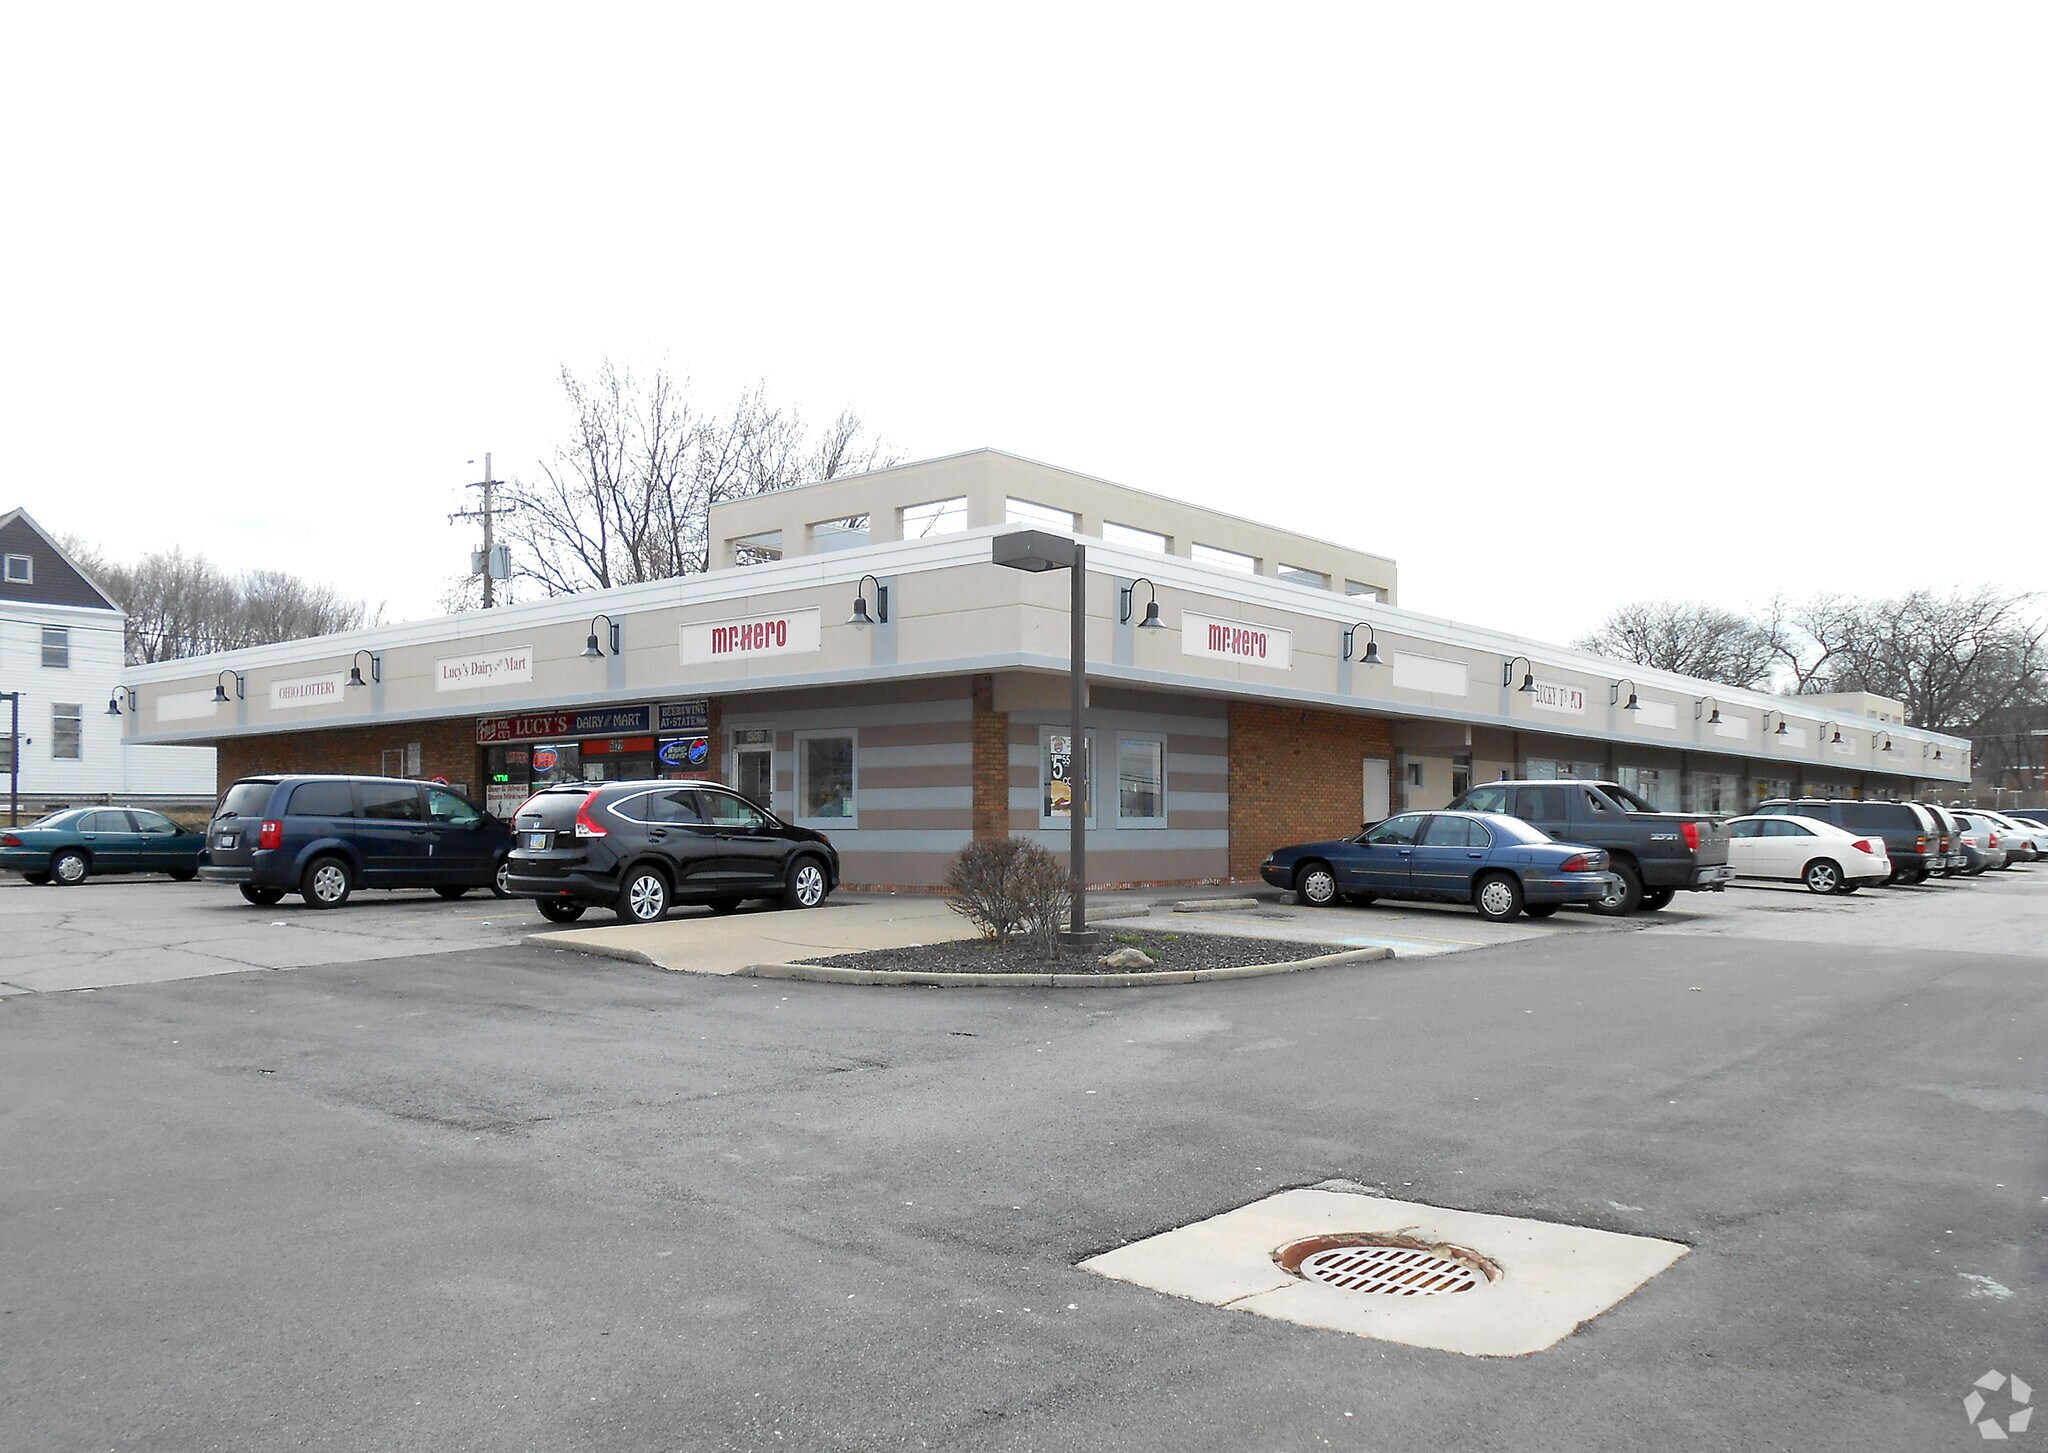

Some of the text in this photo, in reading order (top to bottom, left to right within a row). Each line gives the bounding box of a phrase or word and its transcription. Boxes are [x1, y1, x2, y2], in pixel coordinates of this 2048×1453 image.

[443, 663, 469, 681] Lucy's
[471, 660, 493, 678] Dairy
[504, 657, 527, 671] Mart
[279, 681, 335, 699] OHIO LOTTERY
[516, 716, 567, 735] LUCY'S
[576, 715, 604, 729] DAIRY
[613, 713, 641, 727] MART
[534, 752, 557, 767] OPEN
[492, 774, 509, 782] ATM
